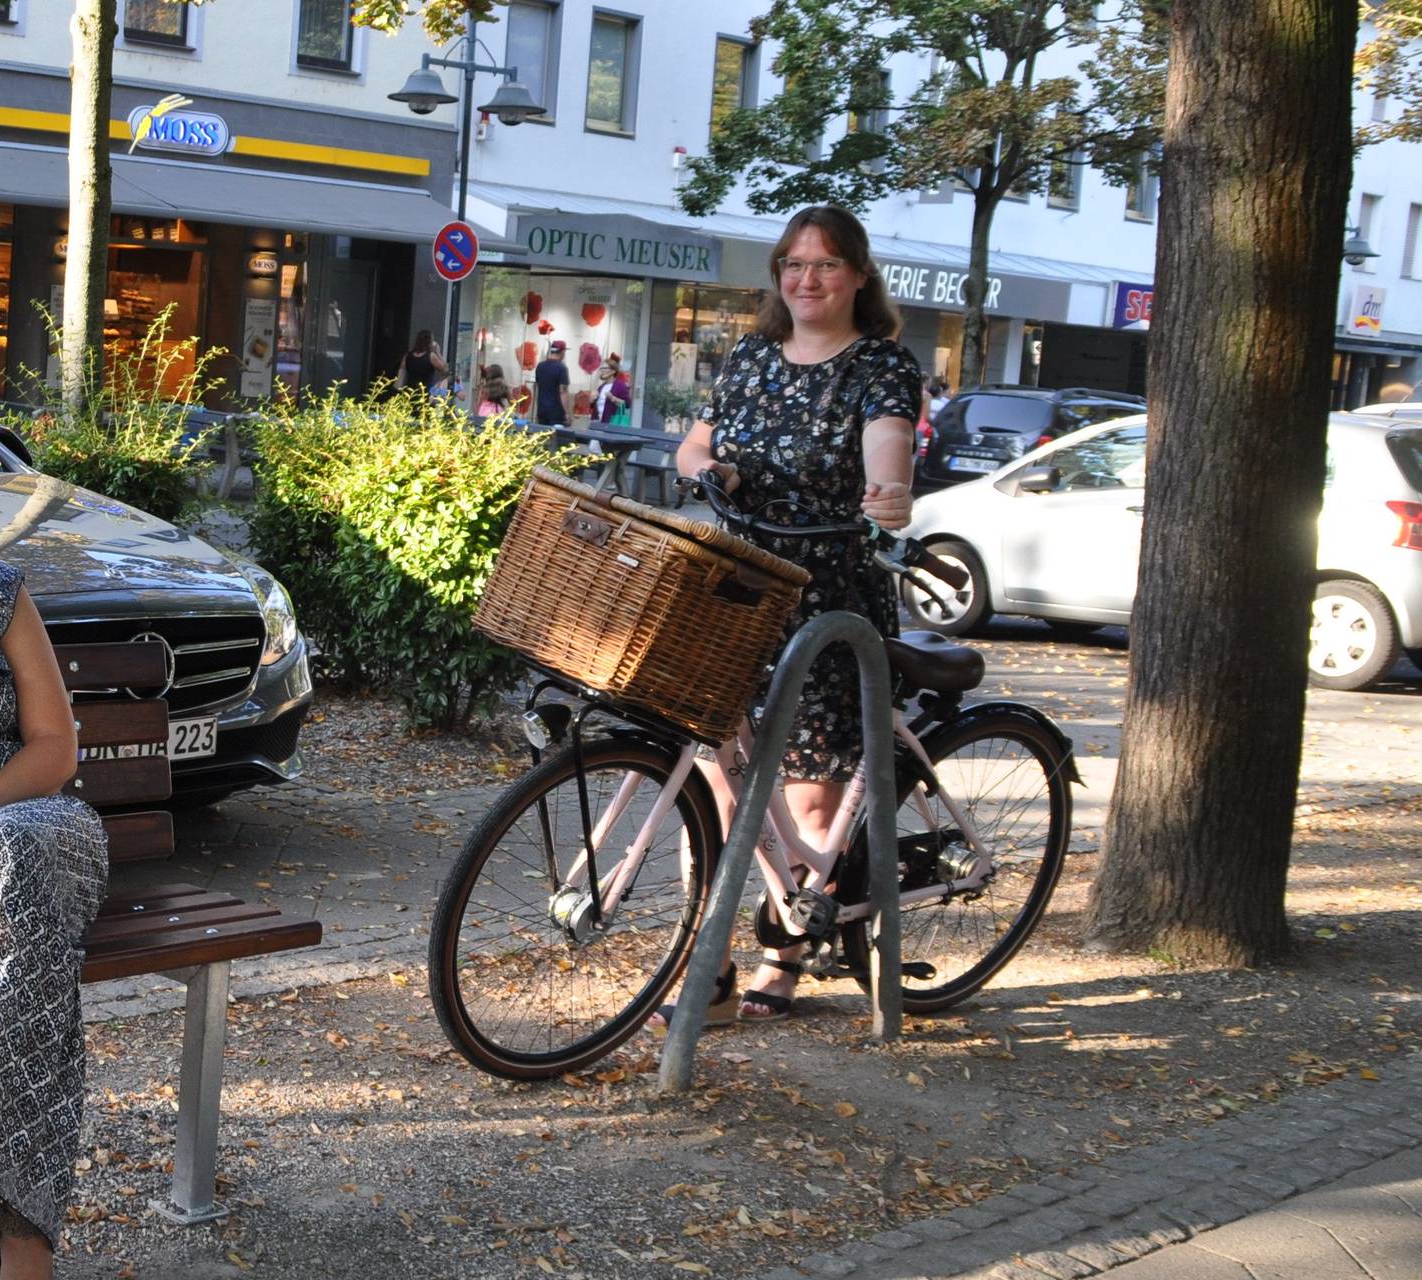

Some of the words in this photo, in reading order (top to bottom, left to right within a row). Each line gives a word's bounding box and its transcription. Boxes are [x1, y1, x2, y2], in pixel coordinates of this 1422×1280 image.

[149, 114, 219, 146] MOSS
[528, 226, 605, 260] OPTIC
[614, 237, 711, 272] MEUSER
[1362, 294, 1382, 318] dm
[174, 721, 215, 755] 223
